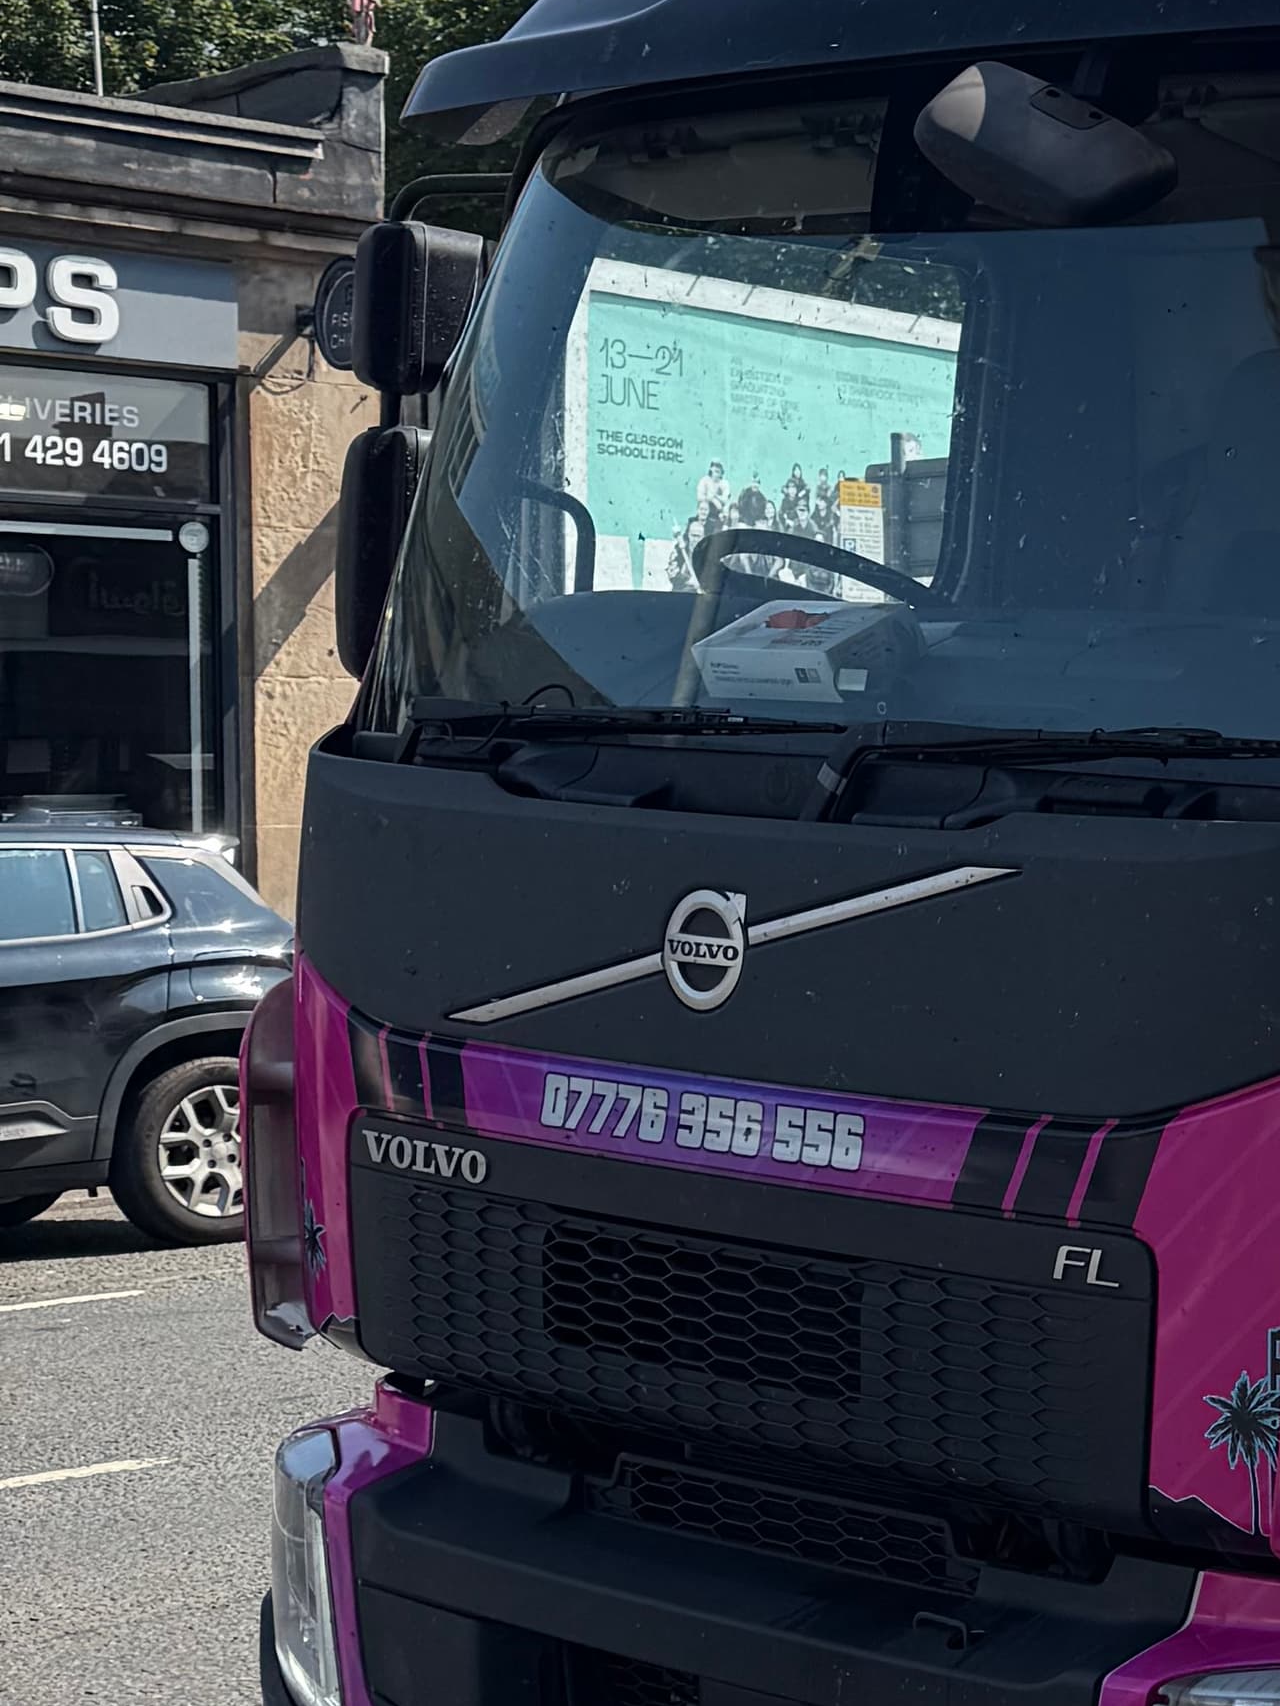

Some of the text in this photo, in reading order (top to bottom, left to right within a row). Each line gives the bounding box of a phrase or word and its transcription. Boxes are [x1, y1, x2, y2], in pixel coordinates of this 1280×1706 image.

[597, 373, 660, 410] JUNE
[24, 434, 84, 468] 429
[92, 439, 168, 474] 4609
[596, 428, 684, 450] THE GLASGOW
[667, 938, 740, 962] VOLVO
[540, 1072, 865, 1172] 07776 356 556
[361, 1129, 488, 1185] VOLVO
[1053, 1245, 1119, 1288] FL
